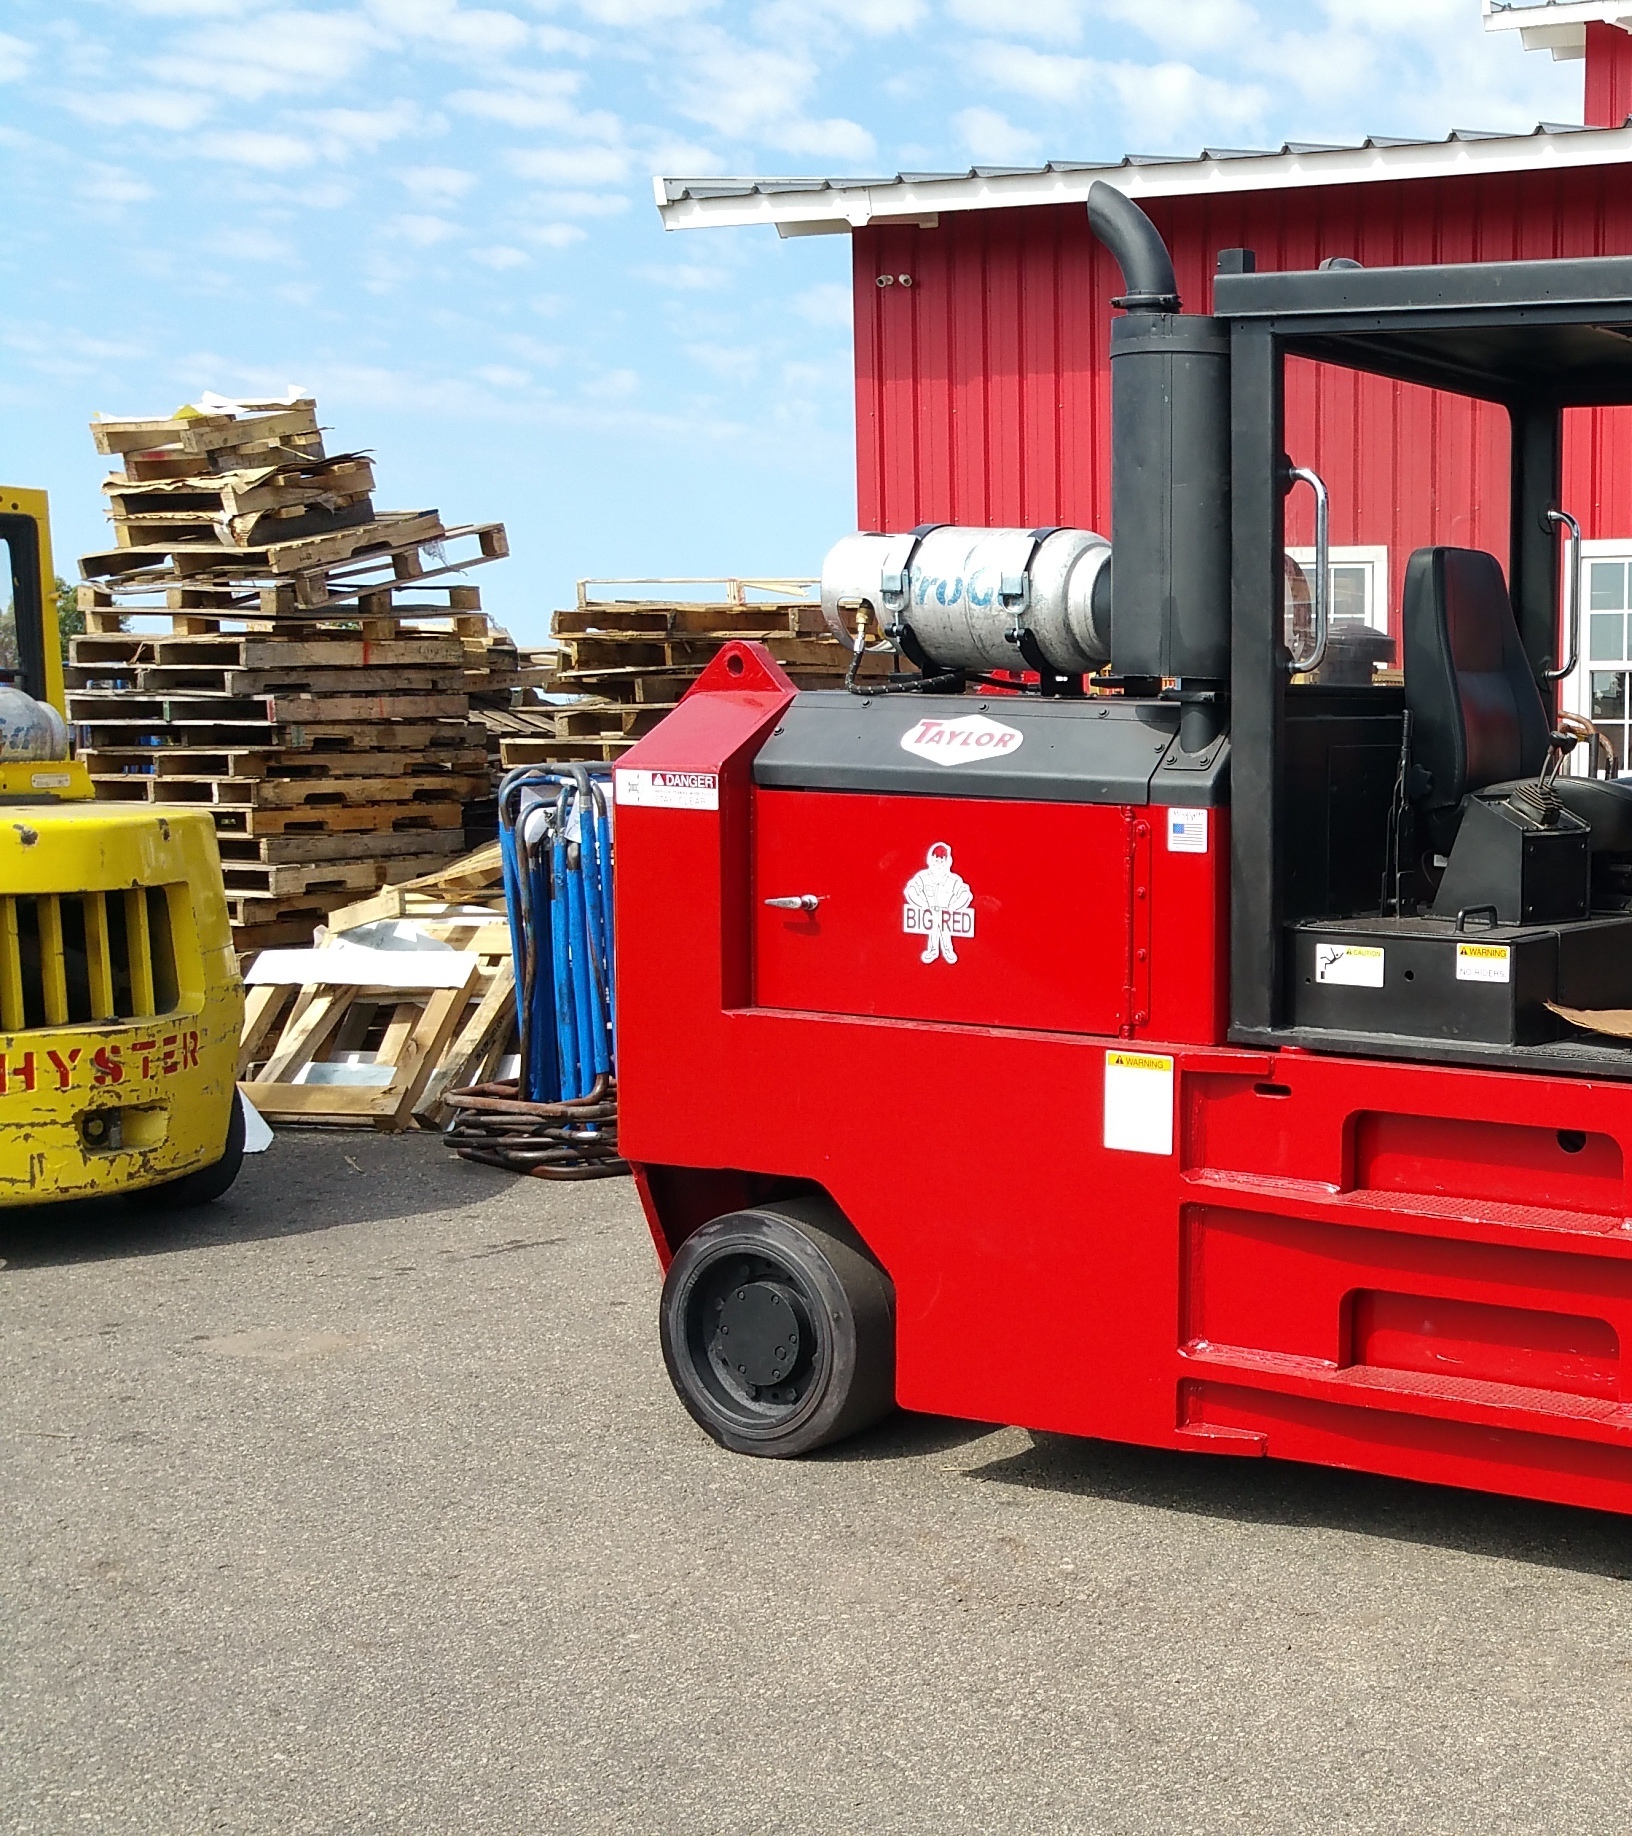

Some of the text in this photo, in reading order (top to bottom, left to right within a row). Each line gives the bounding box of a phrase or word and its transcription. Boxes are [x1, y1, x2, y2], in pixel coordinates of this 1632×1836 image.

[665, 773, 714, 789] DANGER
[906, 907, 972, 934] BIG RED
[1353, 949, 1381, 957] CAUTION
[1469, 948, 1507, 958] WARNING
[1460, 968, 1472, 976] NO
[0, 1030, 199, 1094] HYSTER
[1126, 1057, 1164, 1069] WARNING
